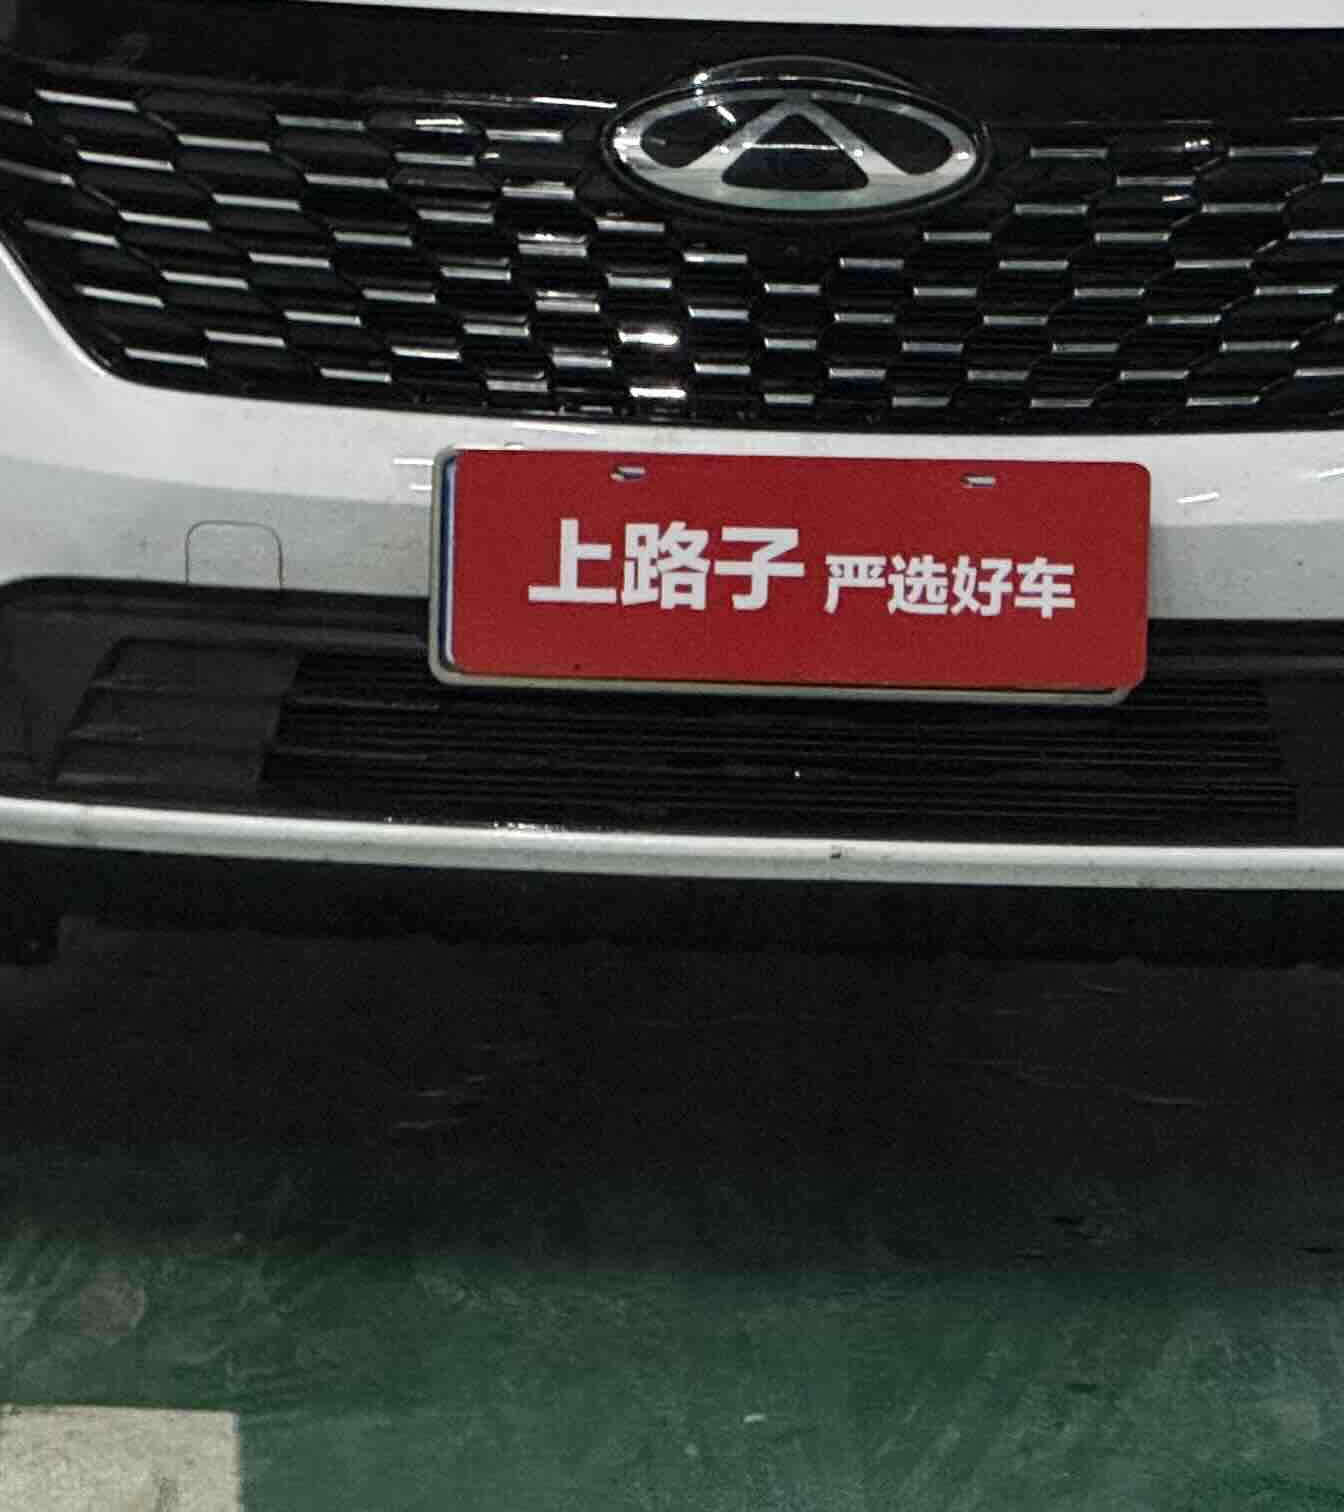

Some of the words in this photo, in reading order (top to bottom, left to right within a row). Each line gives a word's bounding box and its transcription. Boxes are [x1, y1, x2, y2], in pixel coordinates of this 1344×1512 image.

[528, 518, 805, 611] 上路子
[824, 552, 1077, 619] 严选好车
